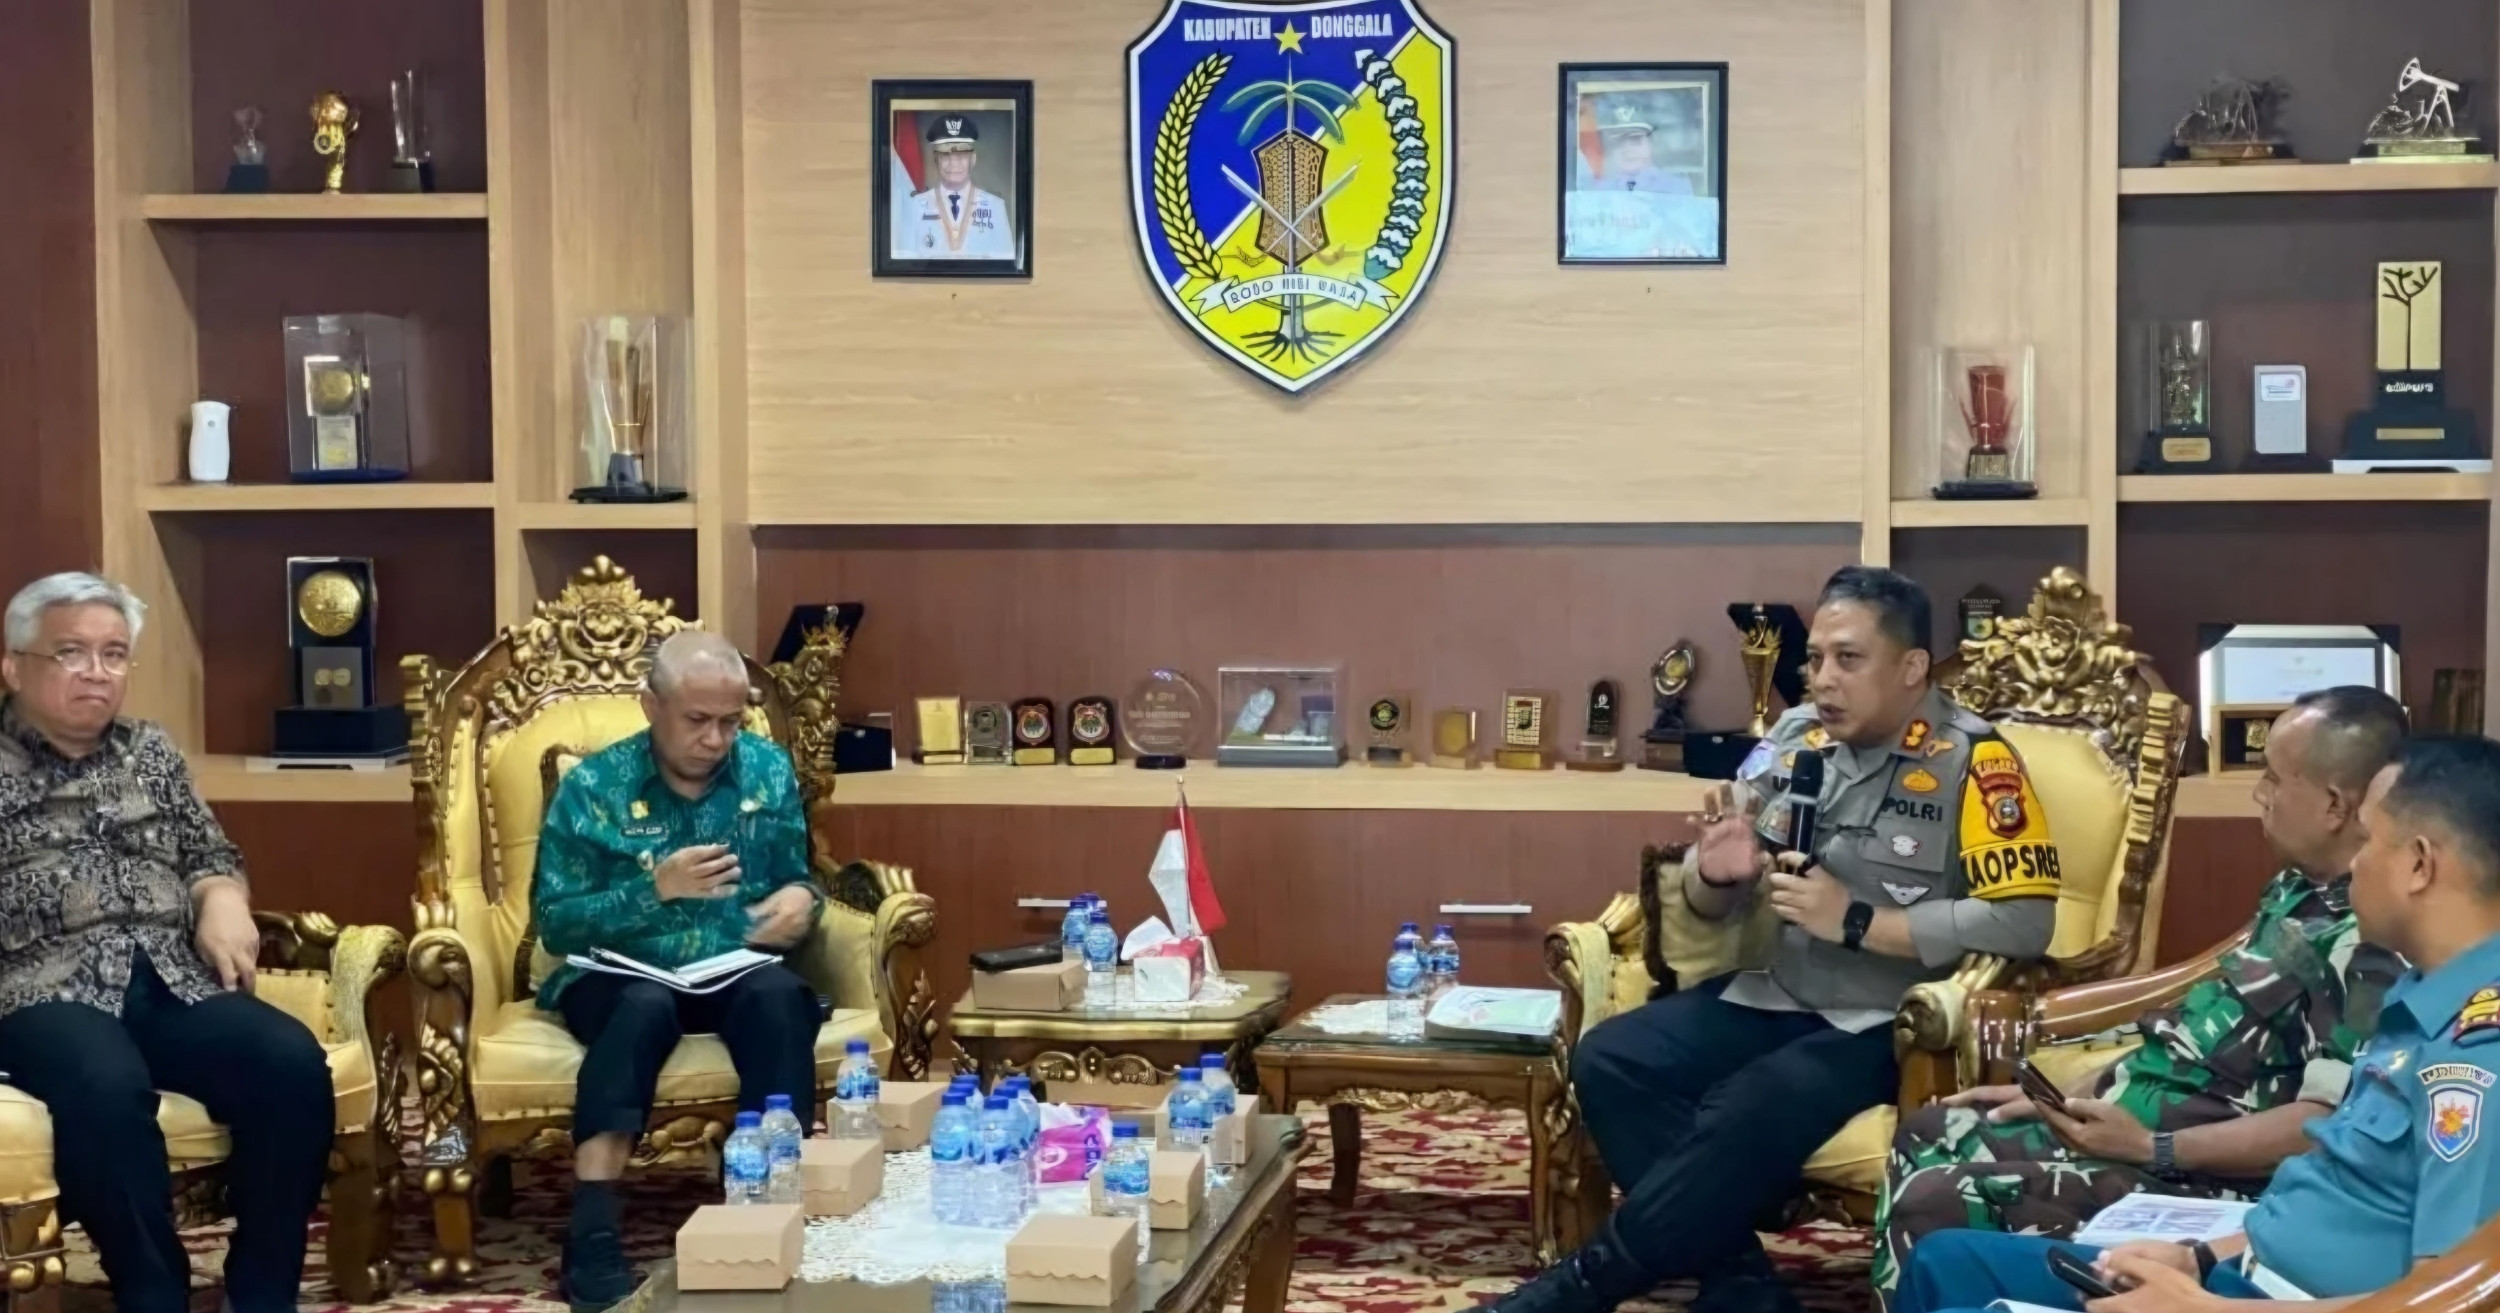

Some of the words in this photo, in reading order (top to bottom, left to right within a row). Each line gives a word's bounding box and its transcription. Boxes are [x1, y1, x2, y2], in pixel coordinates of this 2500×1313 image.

[1184, 17, 1272, 41] KABUPATEN
[1311, 13, 1393, 38] DONGGALA
[1881, 797, 1943, 822] POLRI
